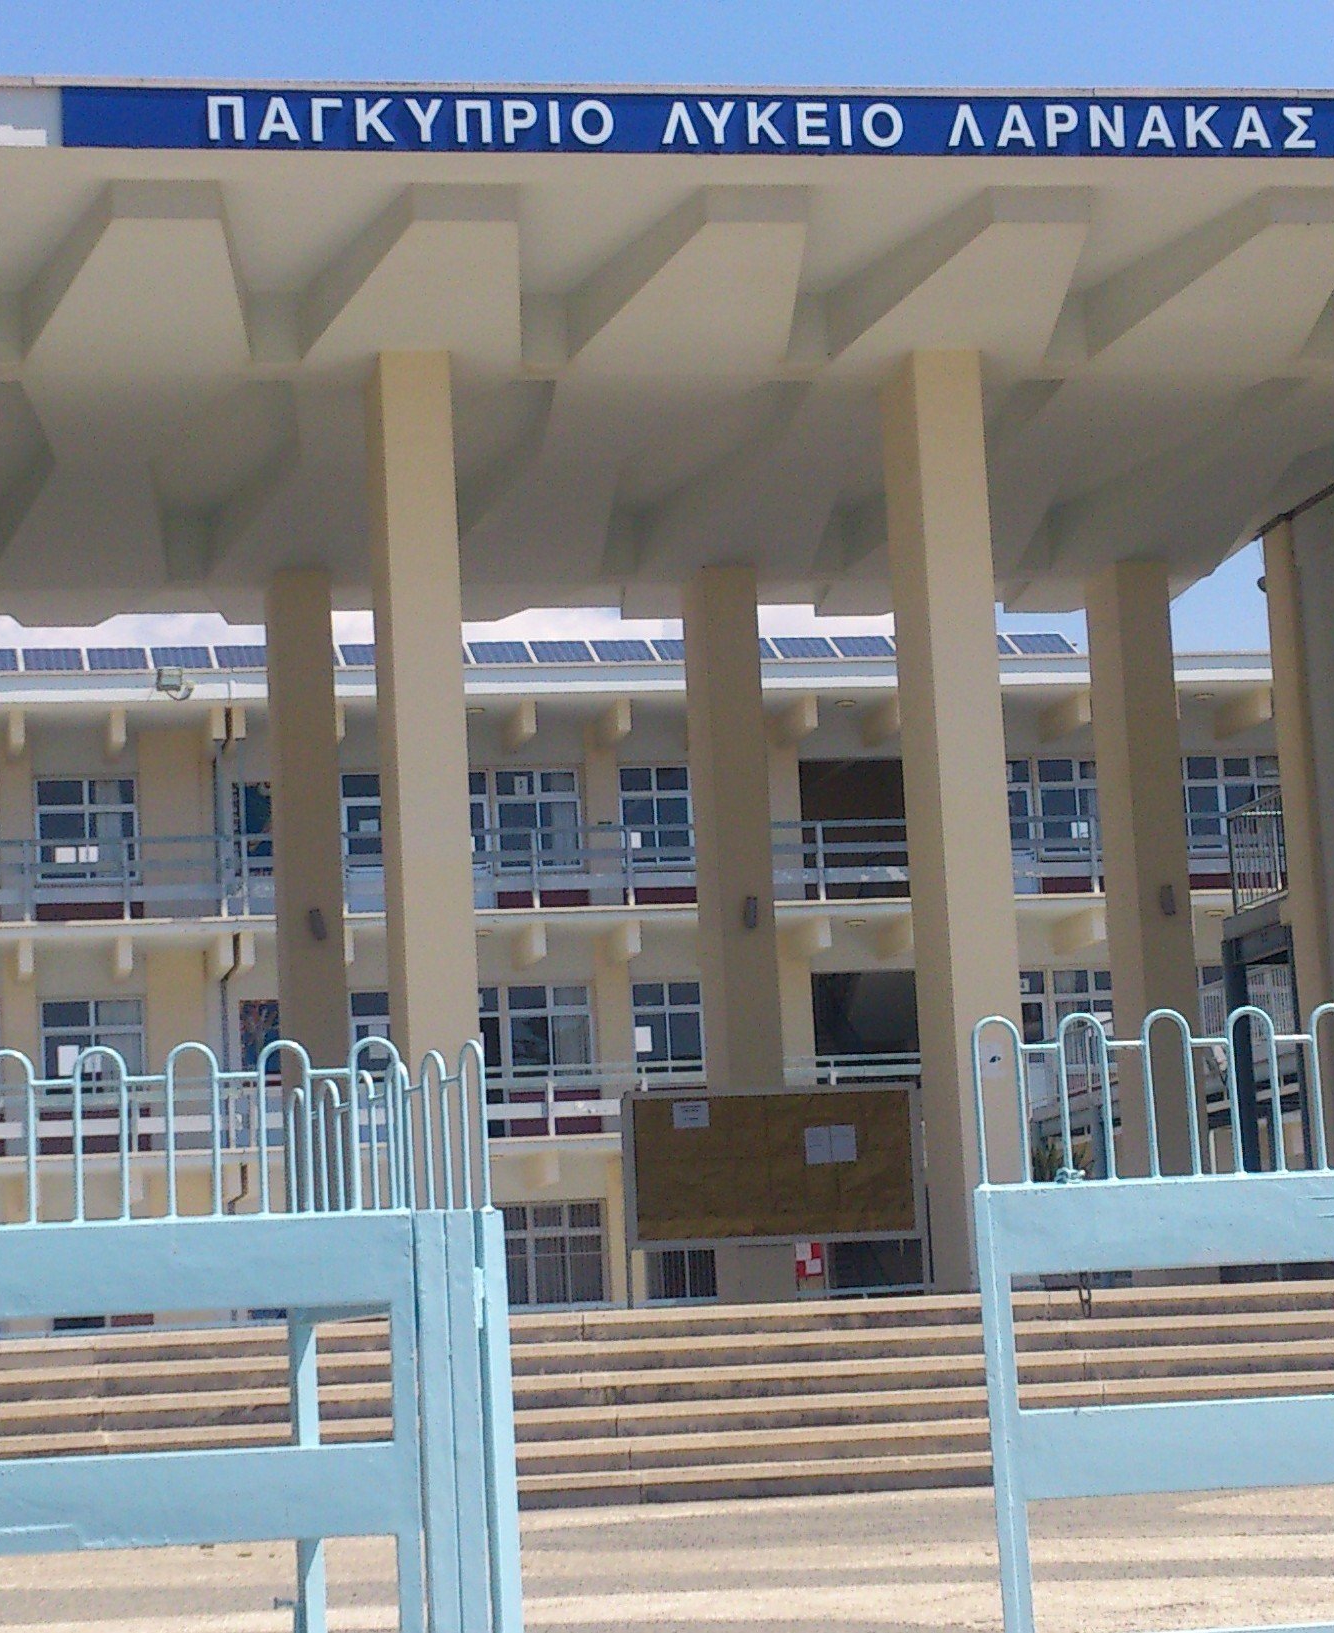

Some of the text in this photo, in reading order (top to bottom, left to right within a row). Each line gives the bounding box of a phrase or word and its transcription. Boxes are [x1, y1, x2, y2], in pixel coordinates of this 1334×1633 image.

[207, 96, 1316, 149] ΠΑΓΚΥΠΡΙΟ ΛΥΚΕΙΟ ΛΑΡΝΑΚΑΣ
